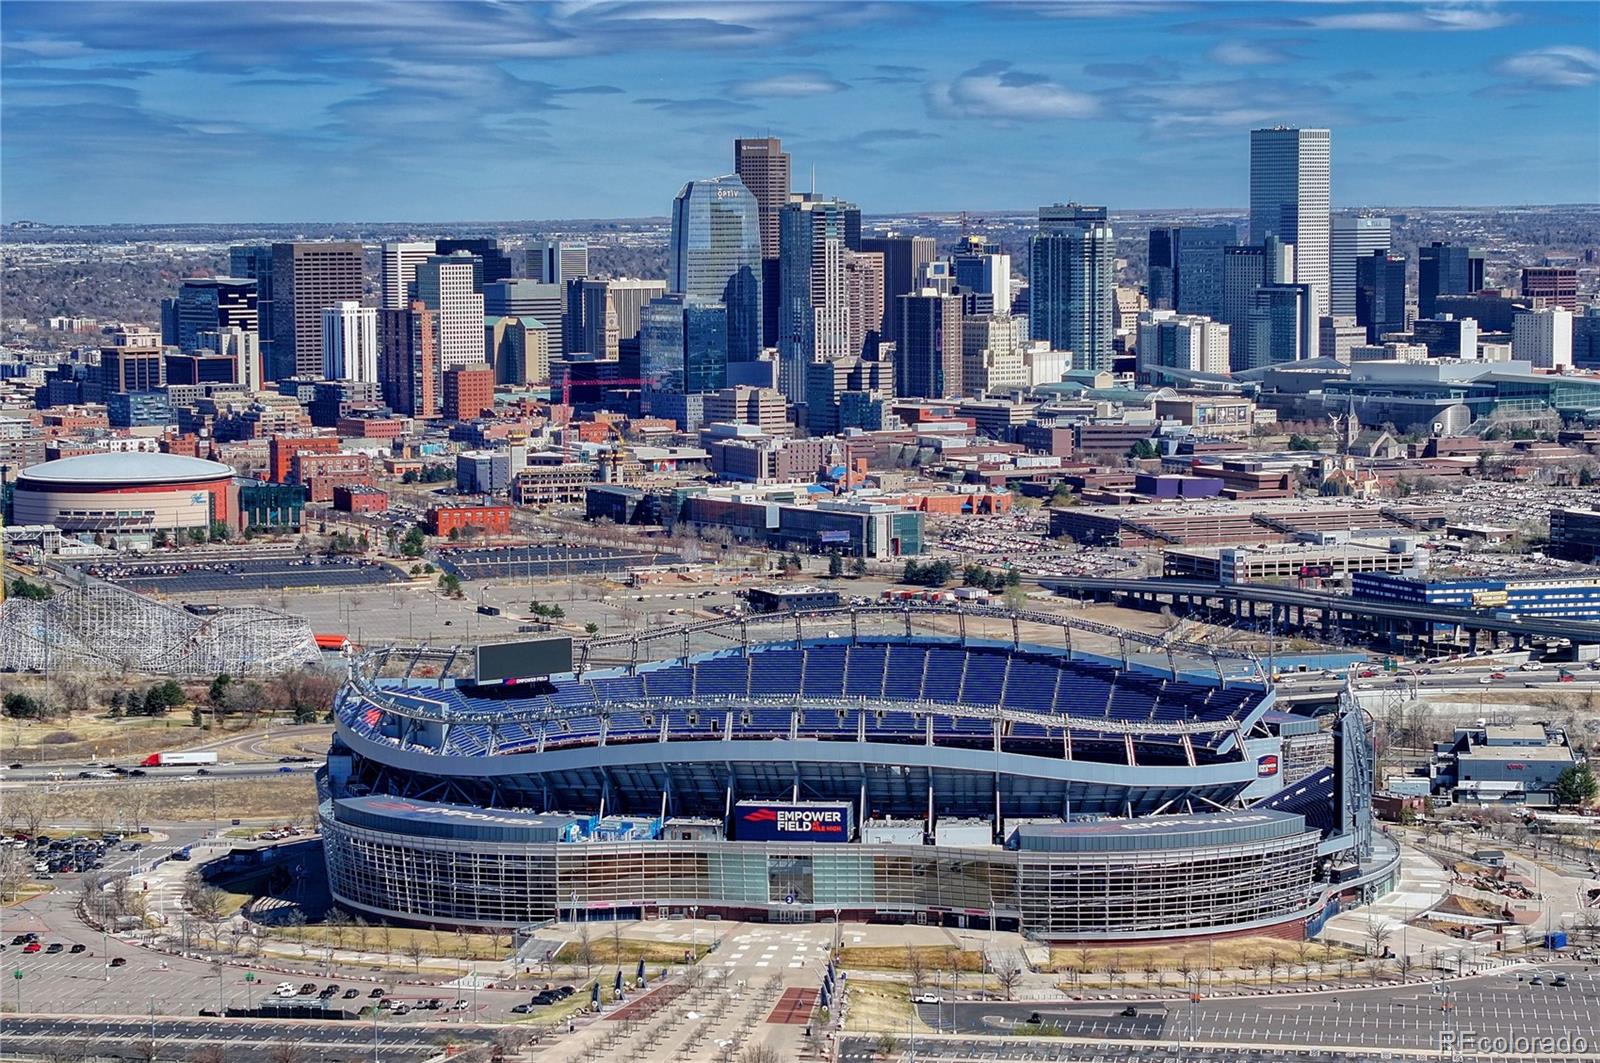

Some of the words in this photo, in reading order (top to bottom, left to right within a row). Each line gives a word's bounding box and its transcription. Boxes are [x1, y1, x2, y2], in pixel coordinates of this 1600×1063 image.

[416, 807, 543, 825] EMPOWER
[777, 811, 842, 822] EMPOWER
[1120, 815, 1273, 829] EMPOWER
[777, 821, 812, 832] FIELD
